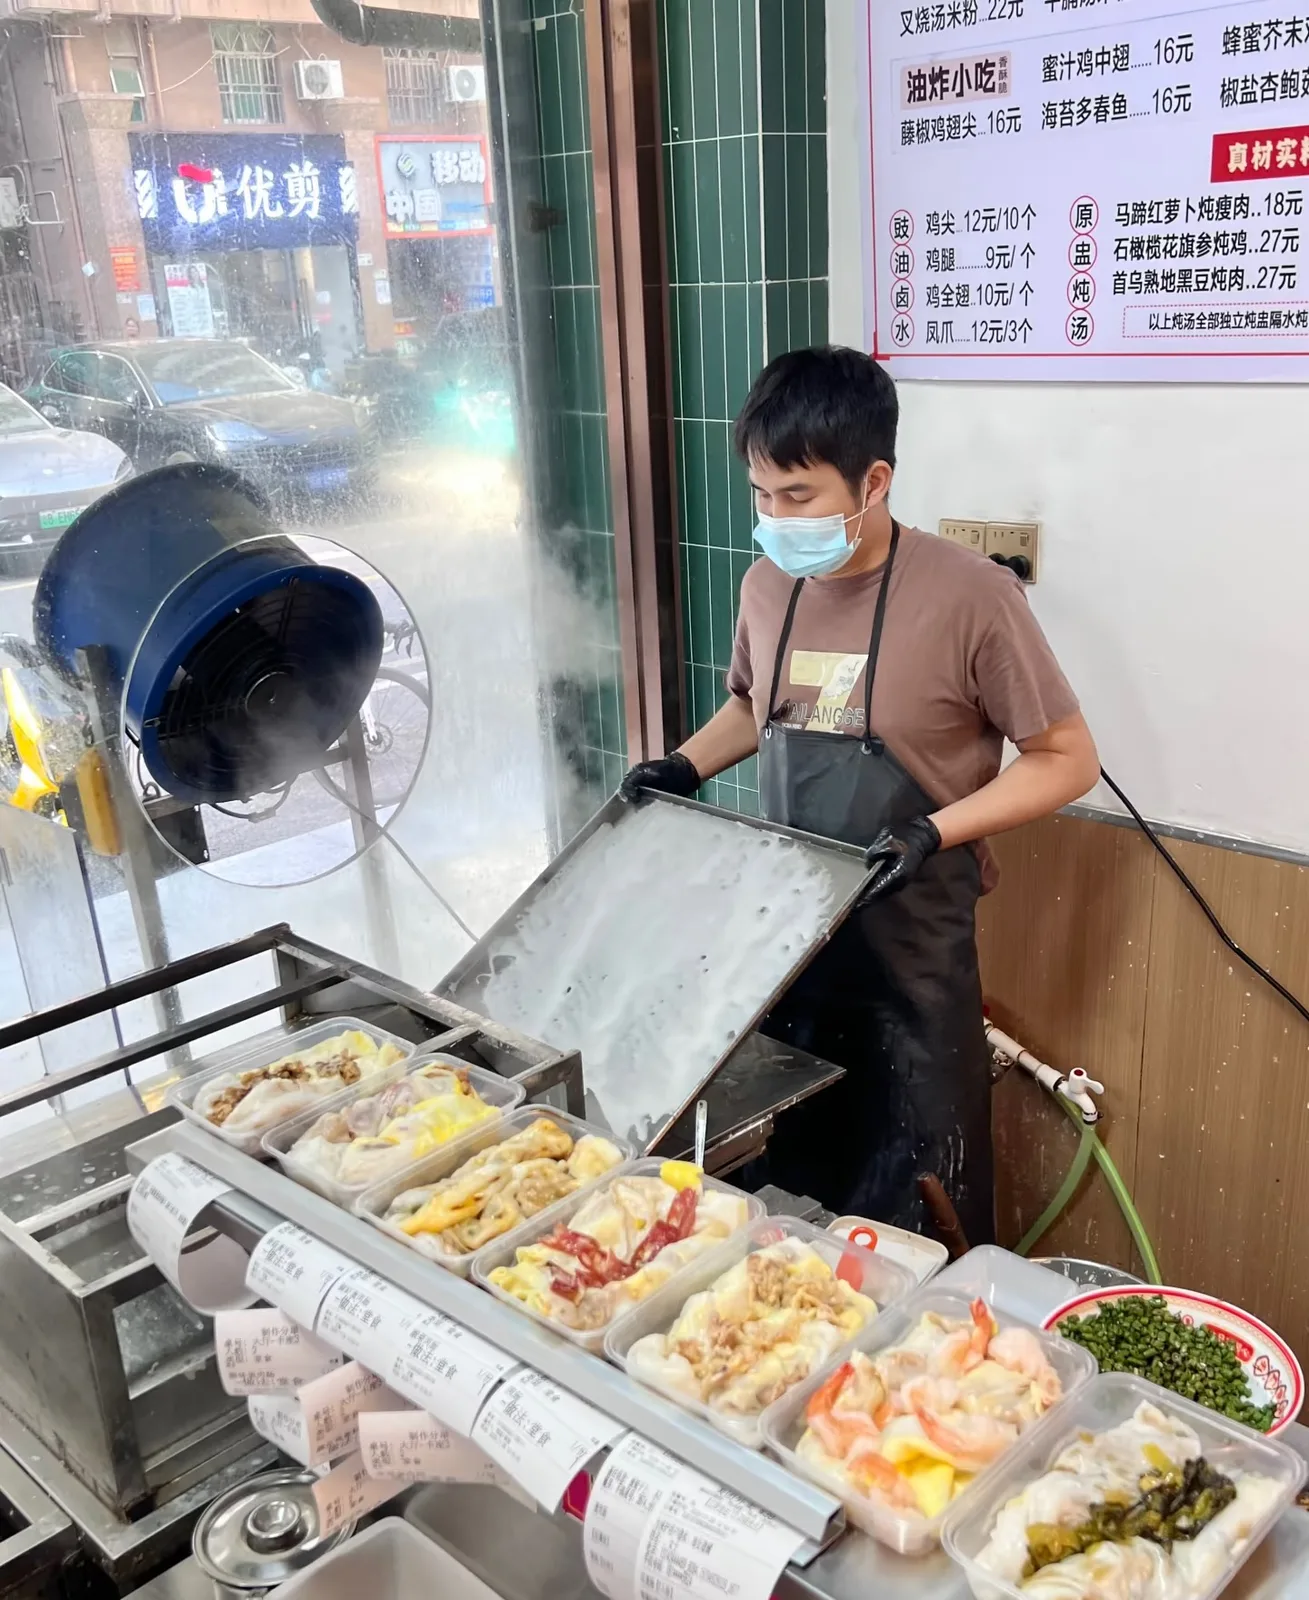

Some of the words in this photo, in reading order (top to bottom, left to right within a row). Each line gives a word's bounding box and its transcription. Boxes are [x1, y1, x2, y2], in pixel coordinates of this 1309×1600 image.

[1042, 43, 1130, 83] 蜜汁鸡中翅
[1153, 33, 1194, 66] 16元
[907, 58, 996, 104] 油炸小吃
[1041, 92, 1128, 130] 海苔多春鱼
[1152, 84, 1192, 114] 16元
[901, 111, 977, 146] 藤椒鸡翅尖
[987, 106, 1022, 134] 16元
[431, 149, 486, 185] 移动
[236, 160, 321, 220] 优剪
[385, 188, 441, 223] 中国
[926, 210, 956, 236] 鸡尖
[1115, 193, 1250, 228] 马蹄红萝卜炖瘦肉
[1264, 189, 1303, 217] 18元
[926, 247, 956, 273] 鸡腿
[1113, 229, 1248, 262] 石橄榄花旗参炖鸡
[1259, 227, 1300, 254] 27元
[926, 283, 970, 308] 鸡全翅
[1112, 265, 1245, 296] 首乌熟地黑豆炖肉
[1256, 264, 1297, 291] 27元
[926, 320, 955, 344] 凤爪
